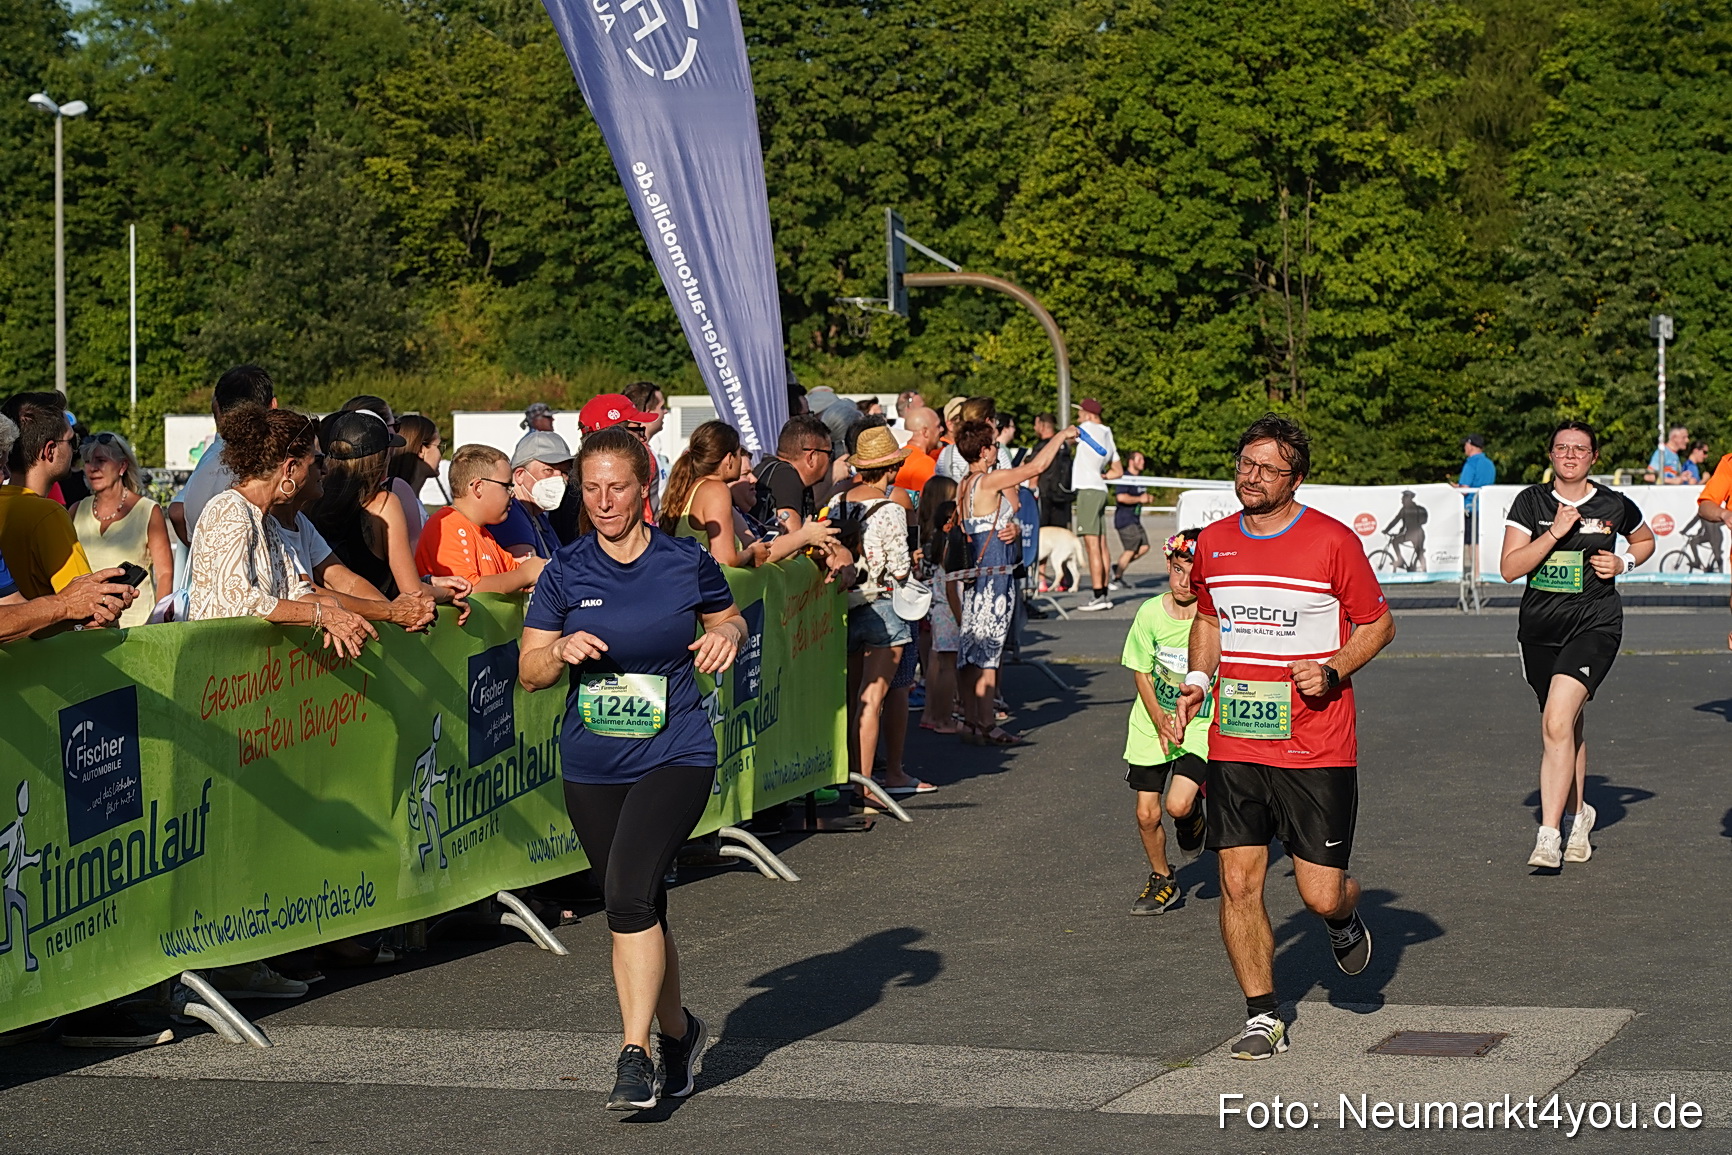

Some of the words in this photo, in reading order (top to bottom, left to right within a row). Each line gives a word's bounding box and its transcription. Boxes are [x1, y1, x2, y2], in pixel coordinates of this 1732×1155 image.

[1540, 565, 1569, 579] 420
[580, 599, 603, 608] JAKO
[1231, 605, 1298, 627] Petry
[1253, 627, 1274, 636] KÄLTE
[480, 679, 509, 707] Fischer
[299, 673, 367, 747] länger!
[583, 702, 592, 723] RUN
[593, 695, 651, 717] 1242
[1229, 699, 1278, 720] 1238
[1279, 705, 1287, 731] 2022
[591, 717, 624, 726] Schirmer
[626, 719, 653, 727] Andrea
[1227, 719, 1252, 728] Buchner
[1254, 721, 1280, 729] Roland
[76, 736, 125, 771] Fischer
[82, 759, 122, 783] AUTOMOBILE
[446, 714, 560, 829] firmenlauf
[451, 812, 499, 858] neumarkt
[40, 777, 212, 926] firmenlauf
[160, 871, 376, 958] www.firmenlauf-oberpfalz.de
[46, 900, 118, 958] neumarkt
